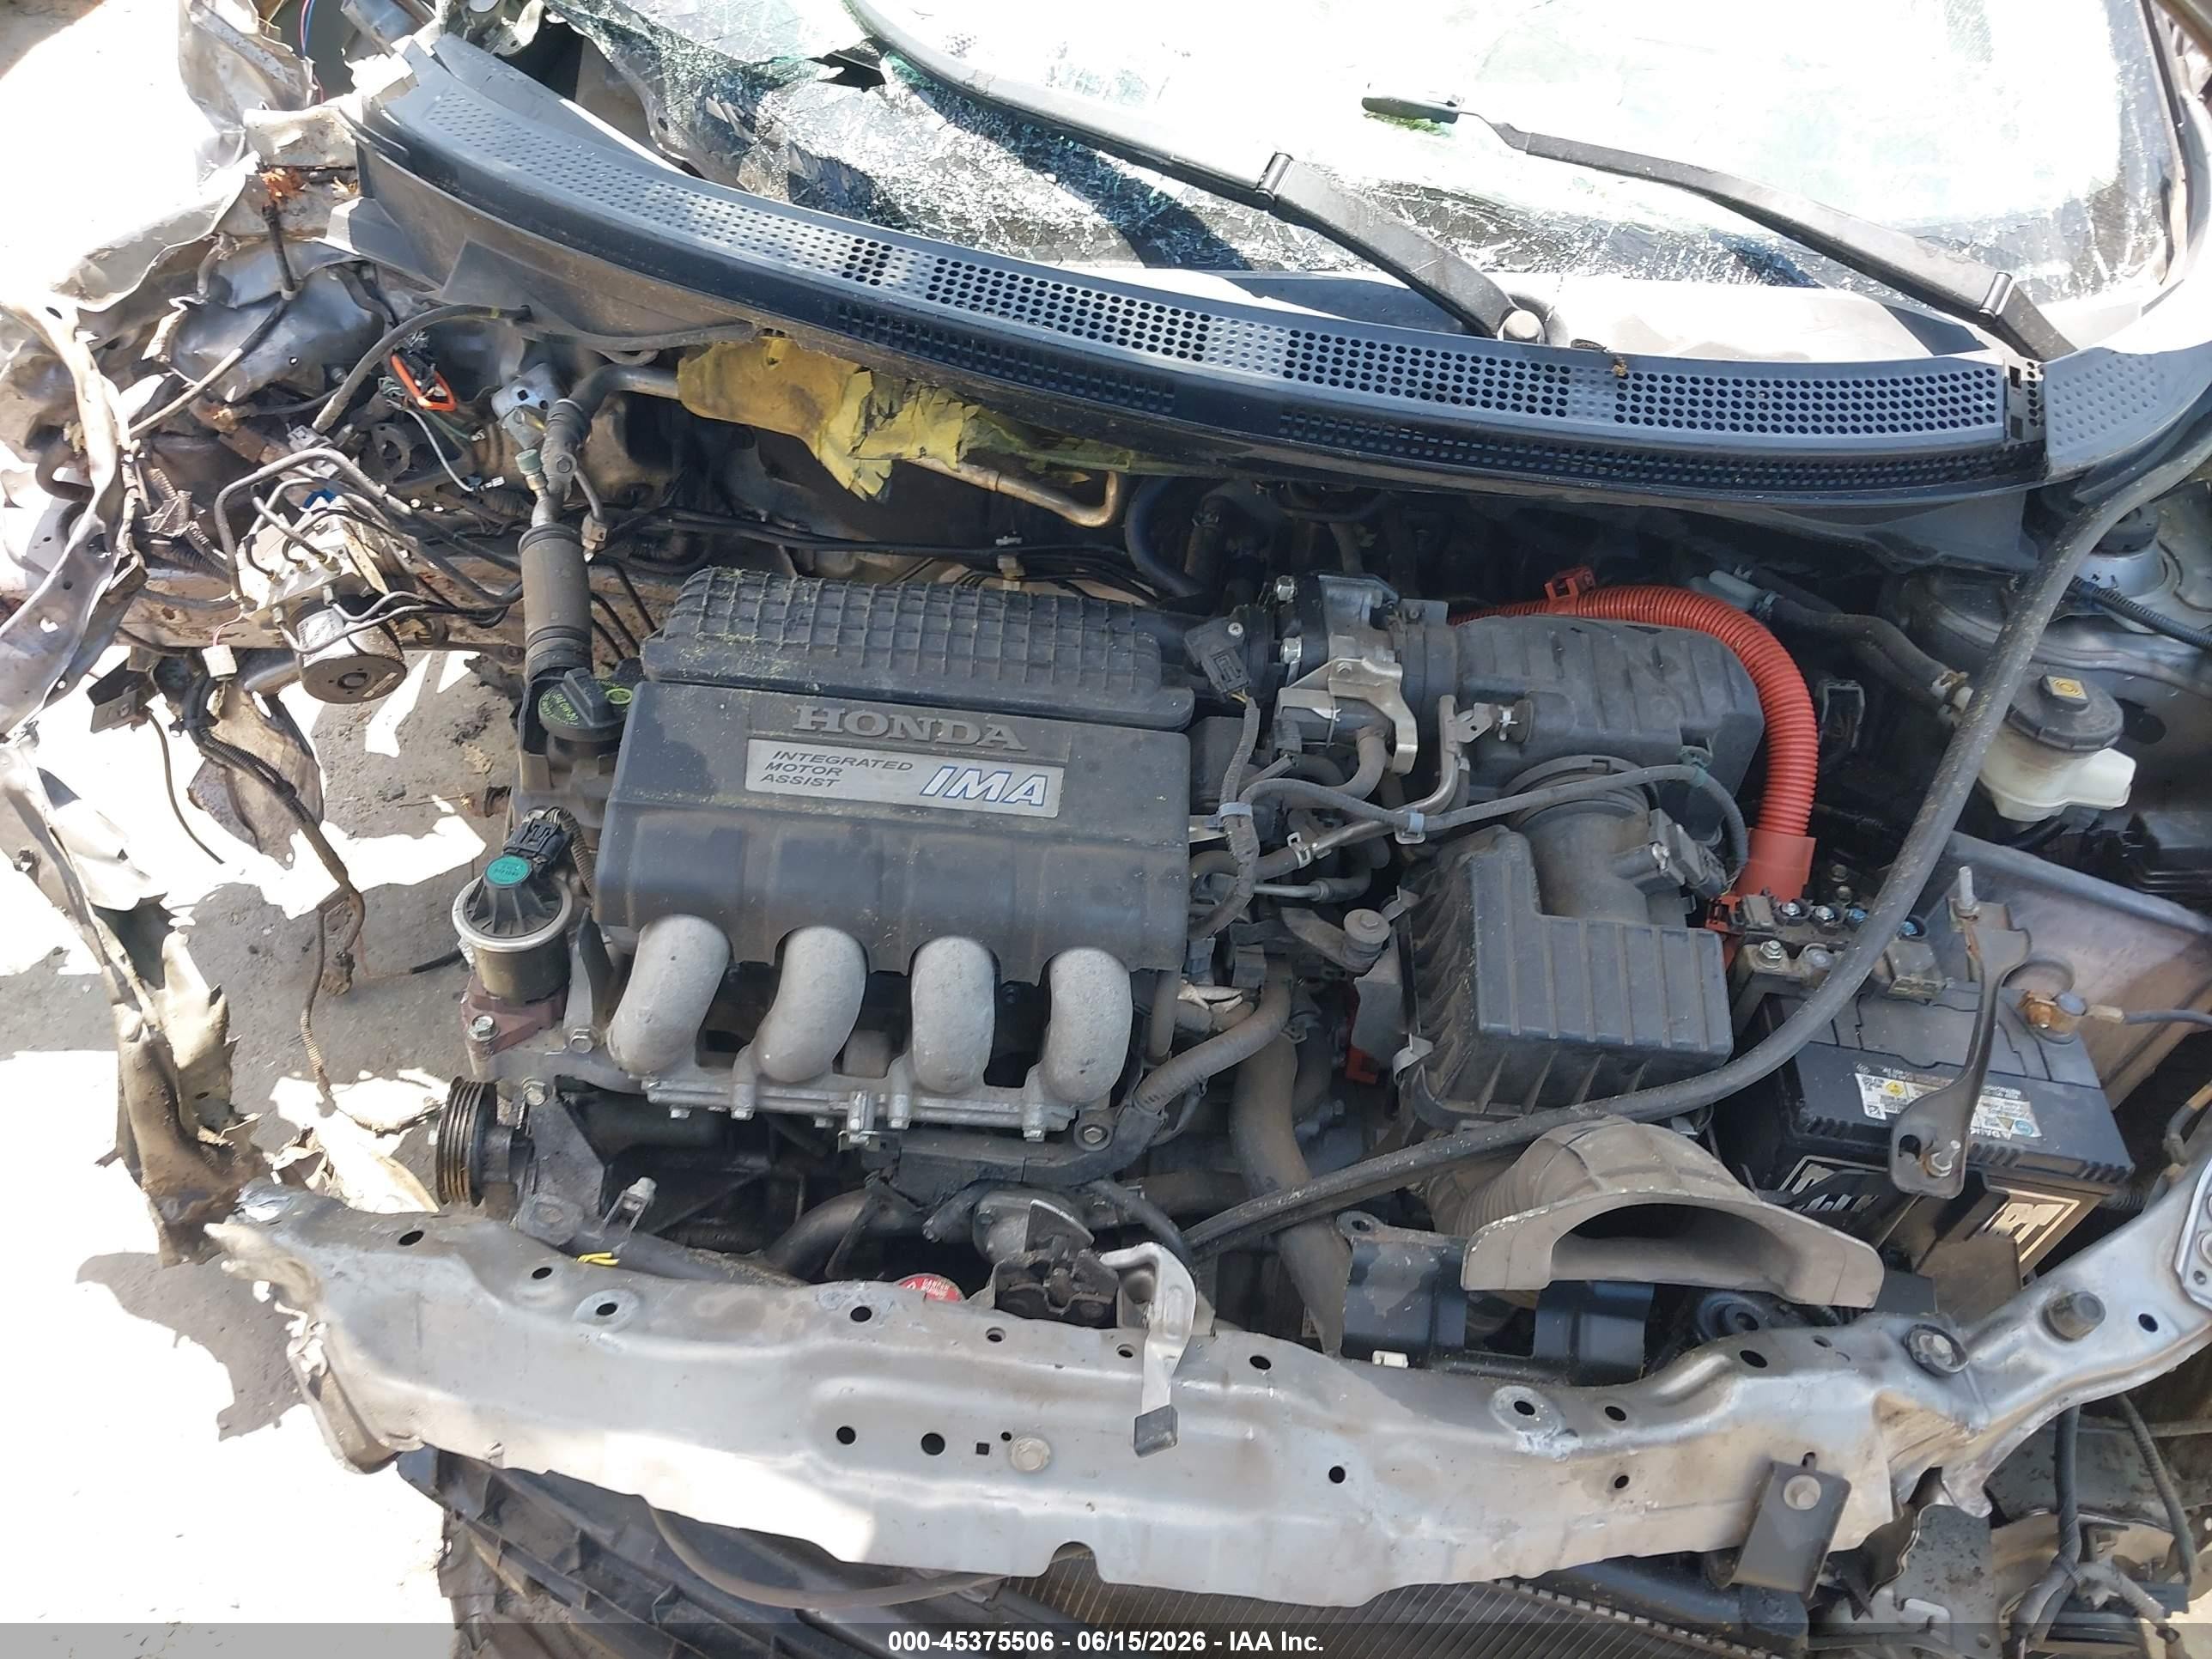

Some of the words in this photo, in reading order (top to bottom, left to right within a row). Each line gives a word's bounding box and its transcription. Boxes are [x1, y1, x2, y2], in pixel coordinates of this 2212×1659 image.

[793, 704, 1028, 751] HONDA
[764, 761, 842, 777] MOTOR
[773, 750, 914, 772] INTEGRATED
[760, 773, 841, 788] ASSIST
[920, 765, 1049, 807] IMA
